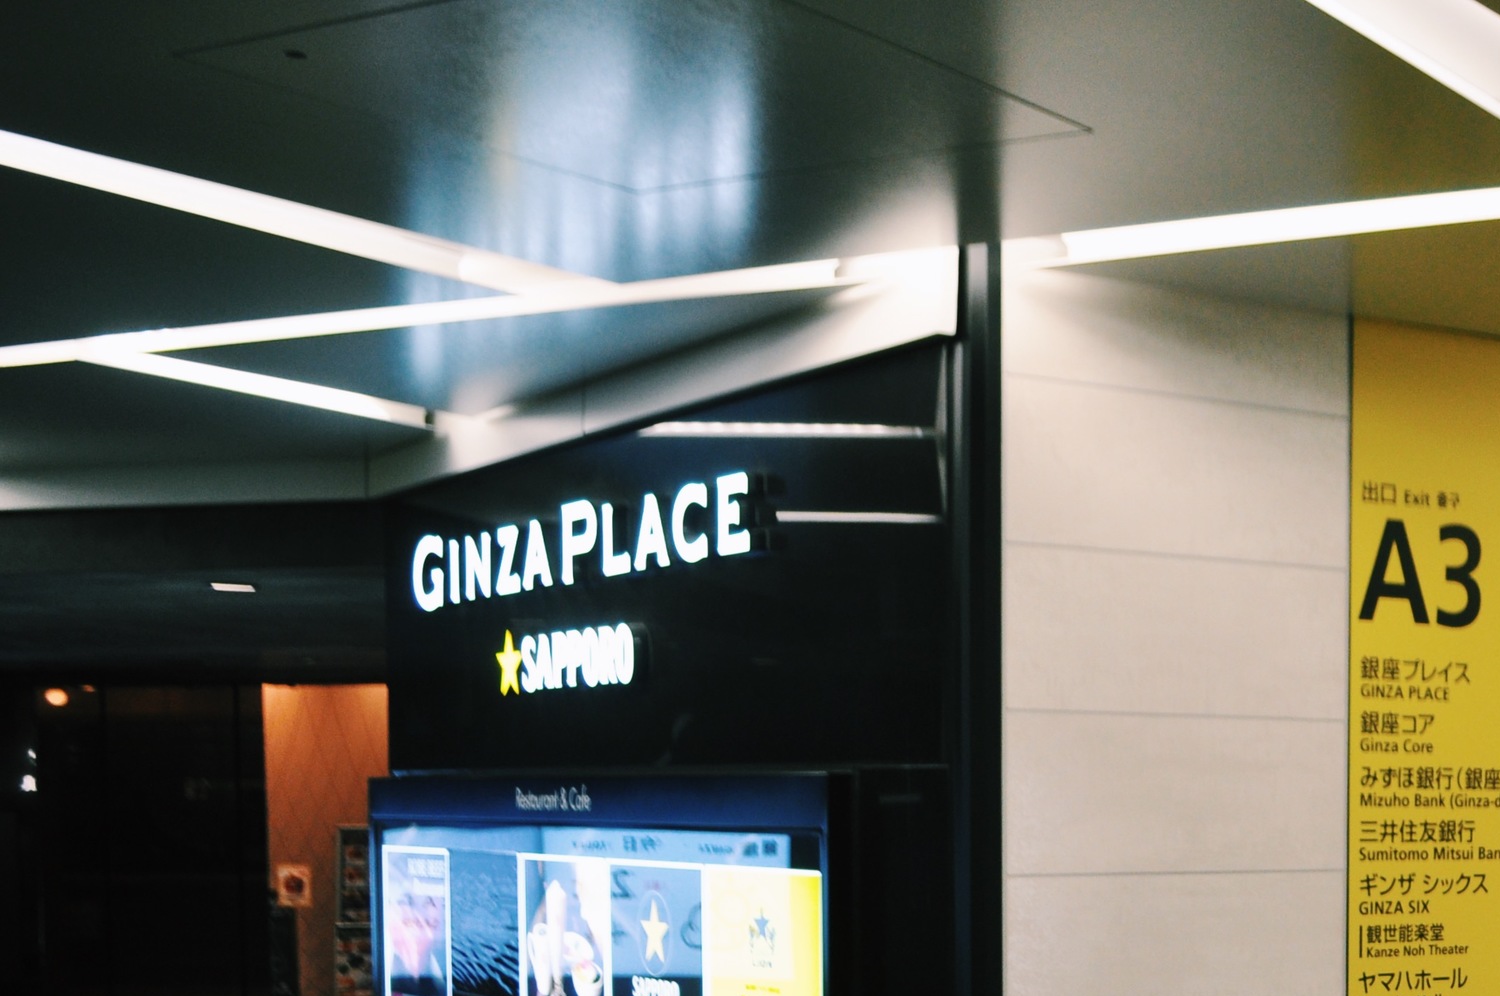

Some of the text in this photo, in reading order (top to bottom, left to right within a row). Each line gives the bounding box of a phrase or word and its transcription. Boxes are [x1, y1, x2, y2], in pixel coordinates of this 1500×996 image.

[1362, 480, 1397, 504] 出口
[1404, 489, 1430, 506] Exit
[412, 471, 751, 612] GINZA PLACE
[1358, 518, 1481, 628] A3
[521, 622, 634, 694] SAPPORO
[1360, 656, 1471, 684] 銀座プレイス
[1360, 683, 1449, 701] GINZA PLACE
[1360, 710, 1435, 735] 銀座コア
[1360, 737, 1434, 753] Ginza Core
[1360, 793, 1410, 808] Mizuho
[1414, 793, 1445, 808] Bank
[1359, 819, 1475, 844] 三井住友銀行
[1359, 846, 1429, 861] Sumitomo
[1433, 846, 1474, 861] Mitsui
[1359, 873, 1488, 897] ギンザ シックス
[1359, 899, 1430, 915] GINZA SIX
[1366, 923, 1445, 944] 観世能楽堂
[1366, 944, 1469, 958] Kanze Noh Theater
[1358, 967, 1468, 994] ヤマハホール
